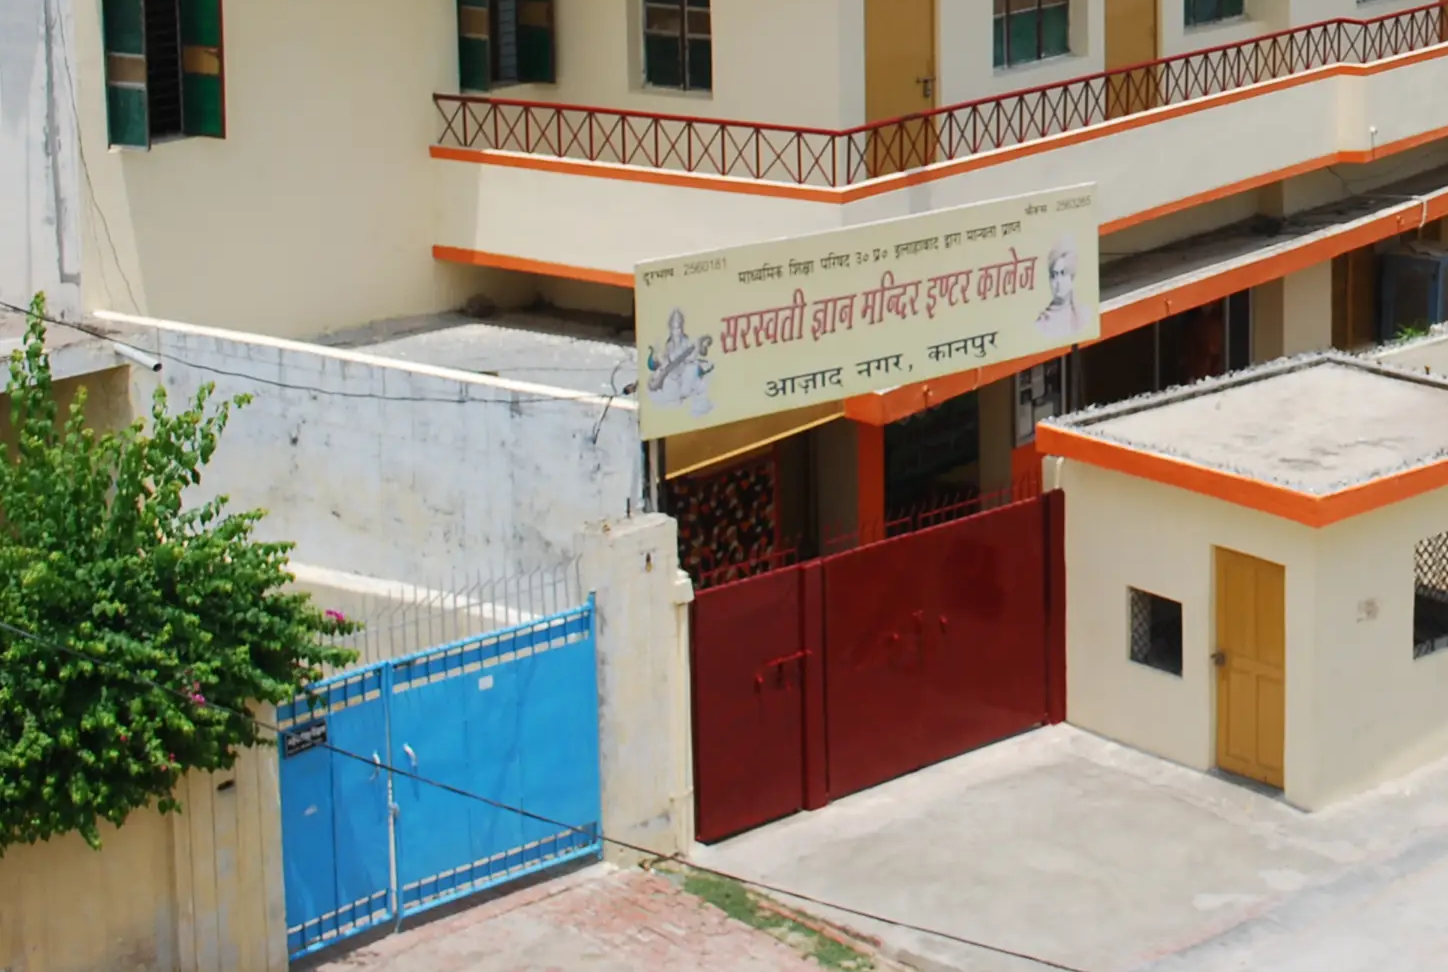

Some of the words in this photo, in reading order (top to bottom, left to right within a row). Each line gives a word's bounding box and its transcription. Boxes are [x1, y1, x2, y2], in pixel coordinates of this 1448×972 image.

[738, 263, 783, 284] माध्यमिक
[788, 258, 814, 276] शिक्षा
[894, 236, 939, 258] इलाहाबाद
[944, 231, 962, 249] द्वारा
[966, 225, 997, 241] मान्यता
[1001, 220, 1021, 237] प्राप्त
[719, 288, 807, 354] सरस्वती
[811, 294, 857, 341] ज्ञान
[861, 270, 921, 325] मन्दिर
[926, 269, 973, 320] इण्टर
[977, 247, 1038, 300] कालेज
[765, 365, 843, 398] आज़ाद
[856, 353, 913, 380] नगर,
[927, 330, 999, 362] कानपुर
